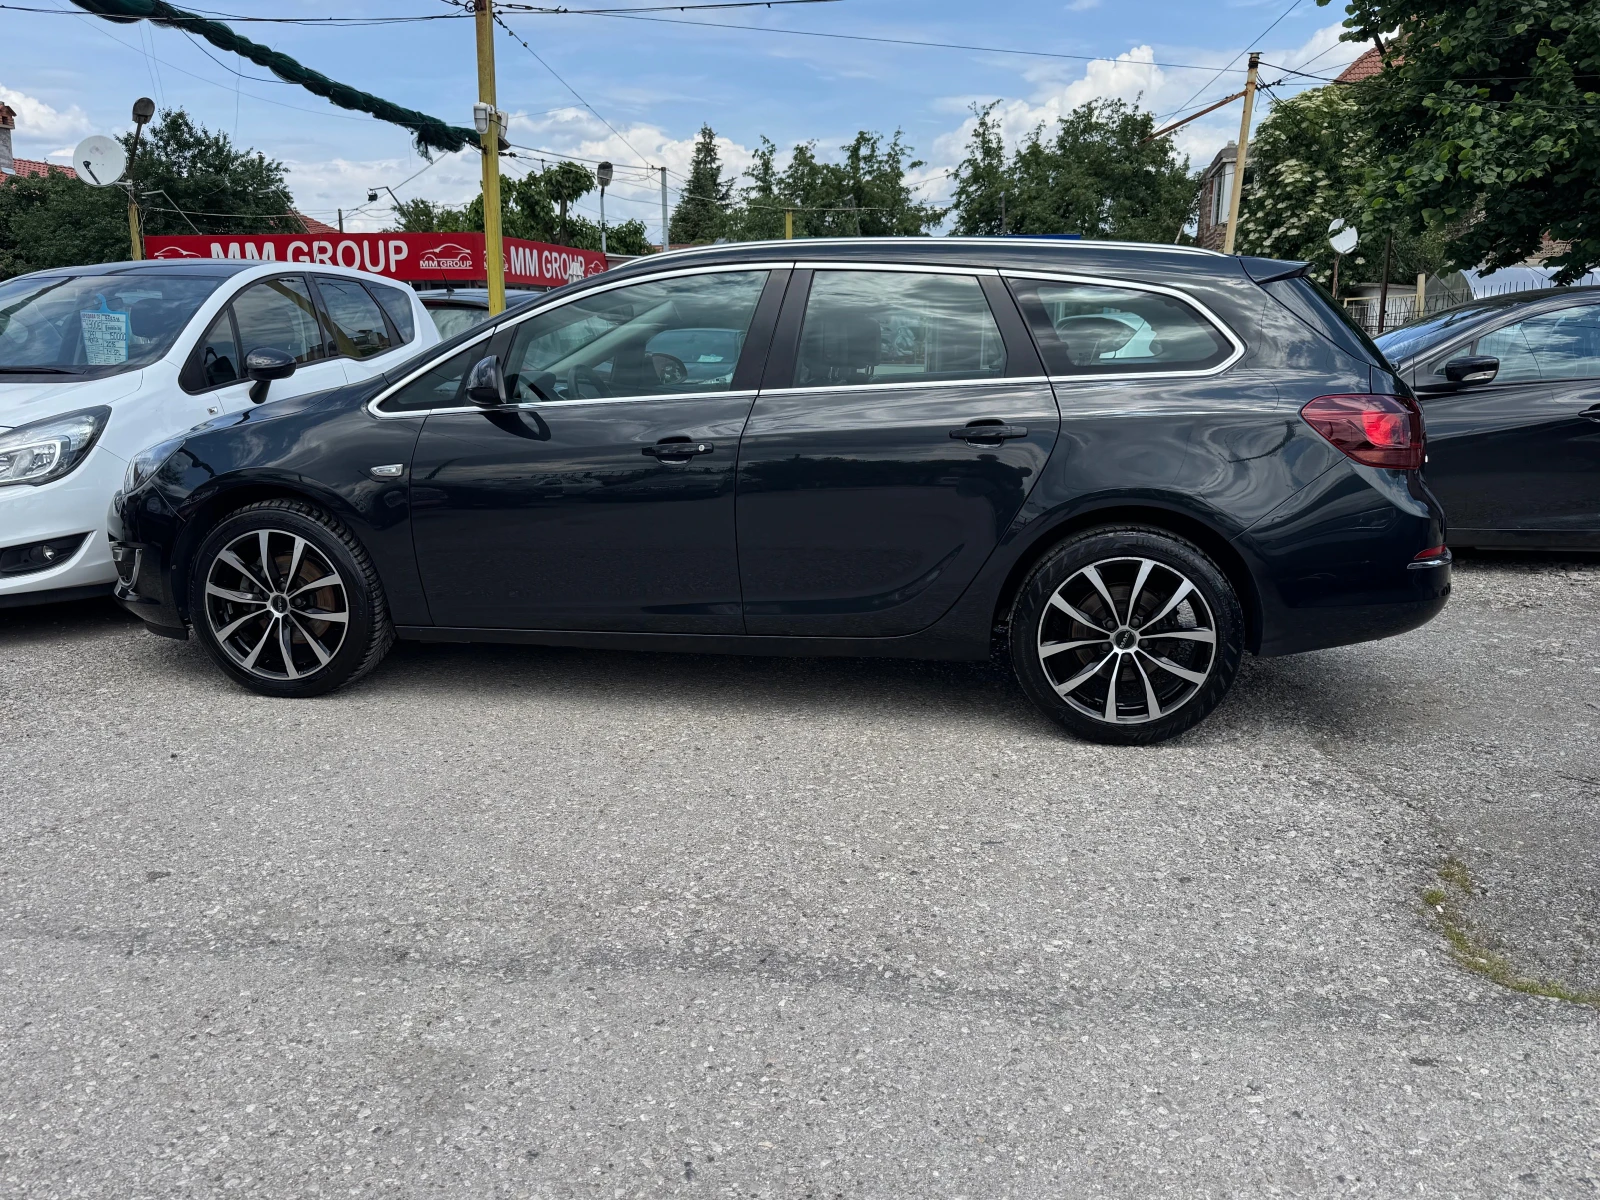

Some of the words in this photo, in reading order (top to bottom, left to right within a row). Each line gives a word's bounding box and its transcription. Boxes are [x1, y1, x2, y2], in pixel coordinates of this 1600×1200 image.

[286, 240, 409, 273] GROUP
[419, 260, 437, 268] MM
[439, 260, 473, 268] GROUP
[510, 245, 539, 278] MM
